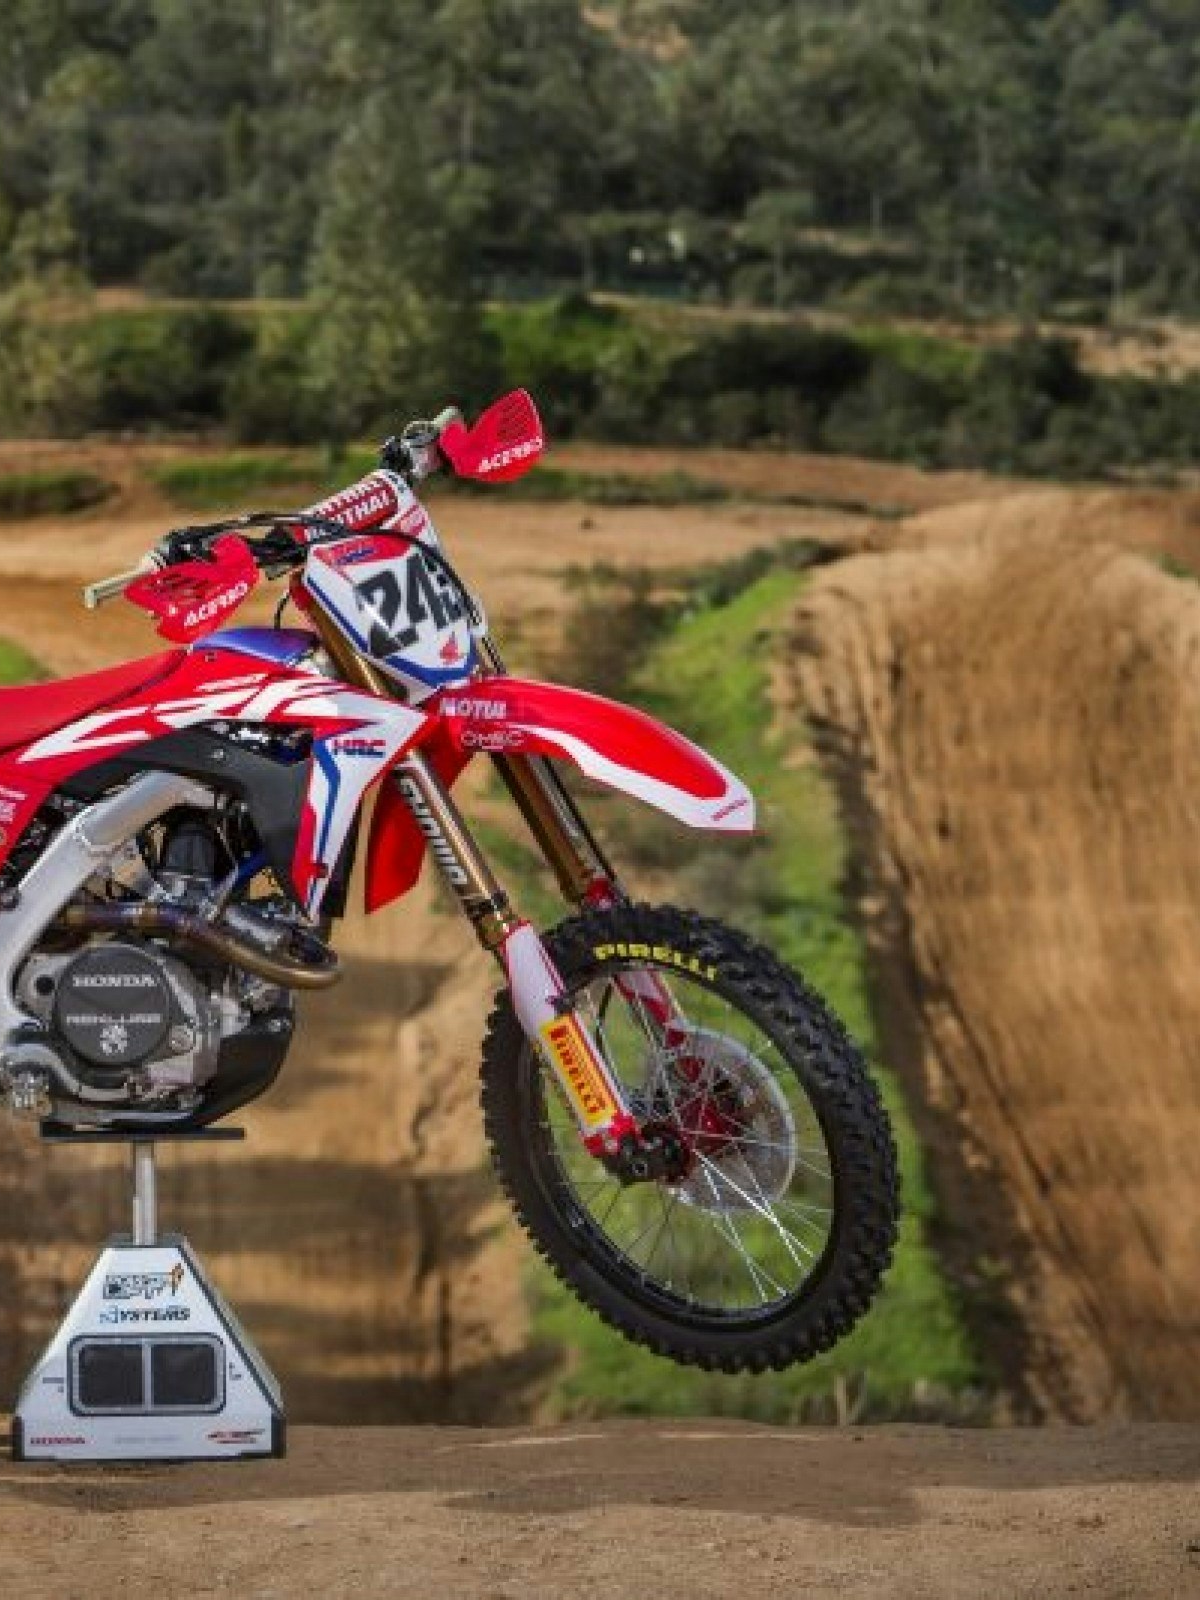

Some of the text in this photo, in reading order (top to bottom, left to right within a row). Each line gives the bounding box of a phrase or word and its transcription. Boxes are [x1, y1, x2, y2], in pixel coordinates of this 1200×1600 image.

[438, 697, 507, 719] MOTUL
[333, 738, 387, 759] HRC
[594, 942, 718, 981] PIRELLI
[72, 973, 160, 987] HONDA
